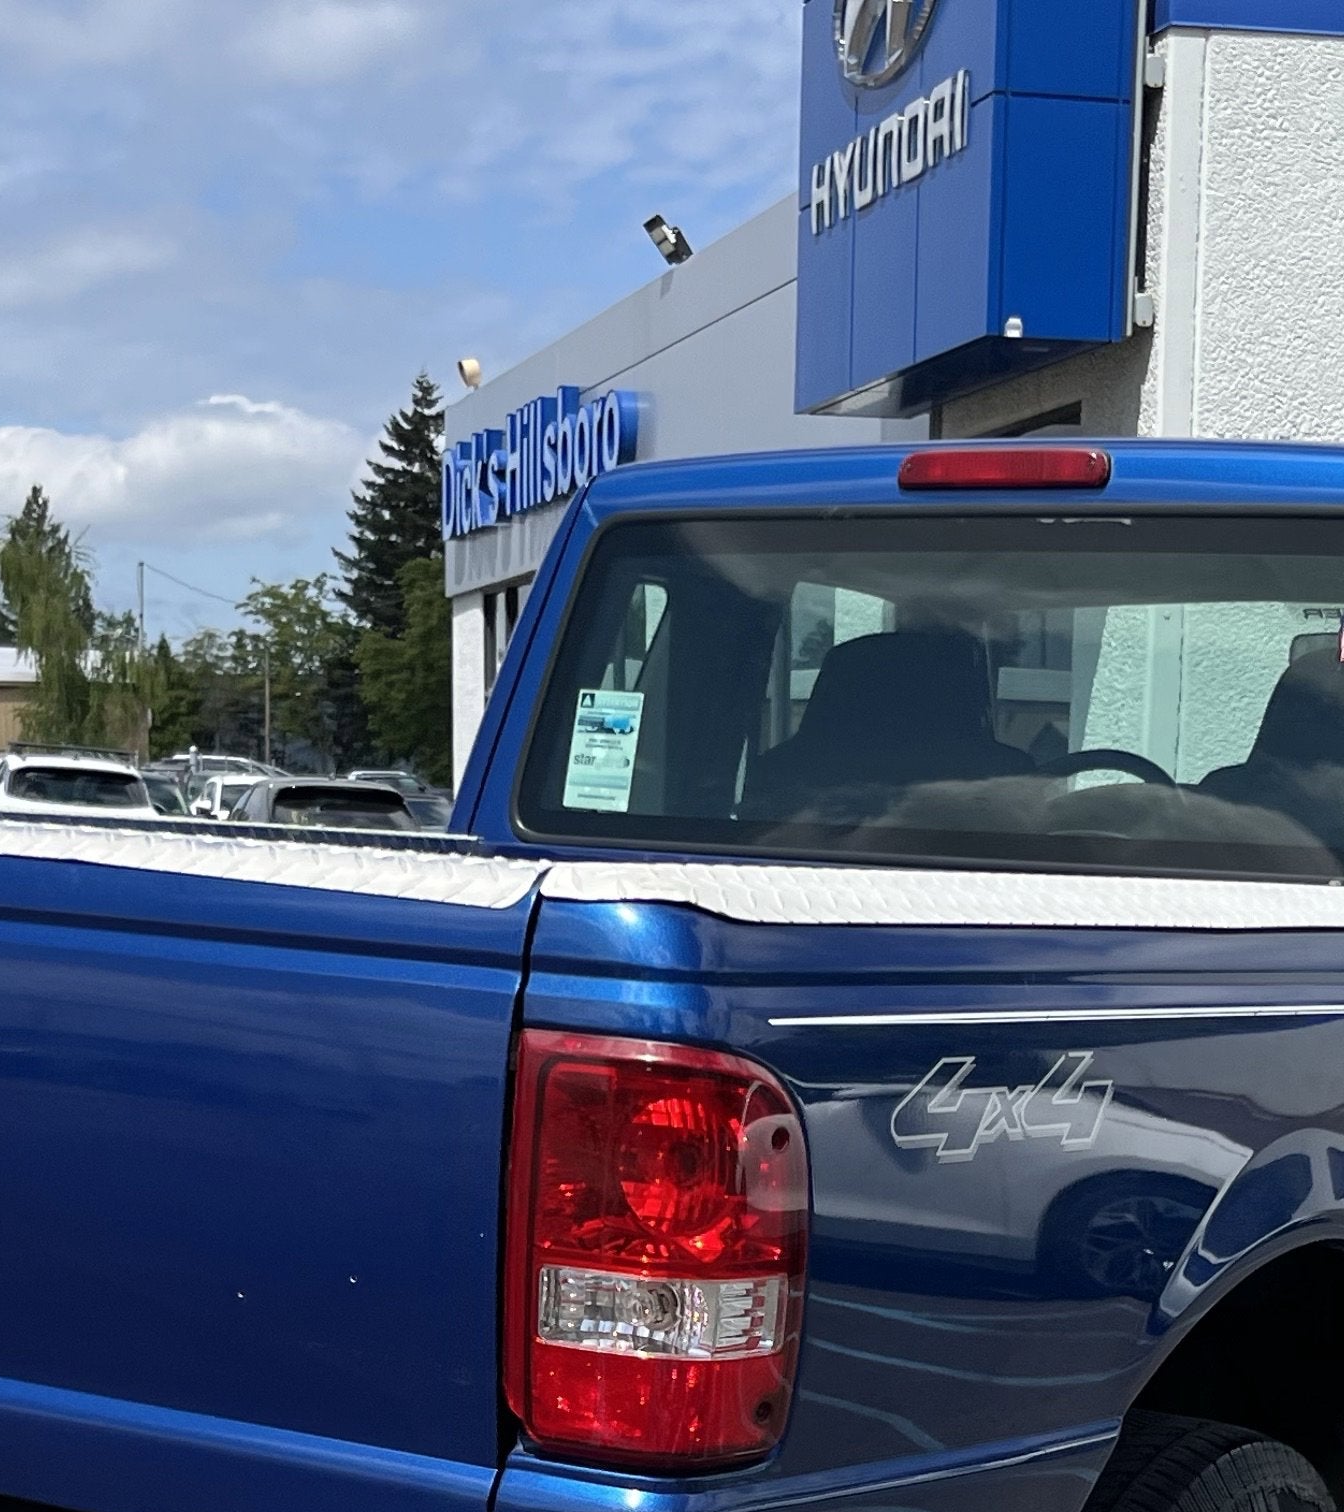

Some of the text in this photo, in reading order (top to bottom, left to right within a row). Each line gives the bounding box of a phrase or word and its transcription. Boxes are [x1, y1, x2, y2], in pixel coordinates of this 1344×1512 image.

[811, 68, 970, 236] HYUNDAI
[442, 386, 626, 541] Dick's Hillsboro
[890, 1050, 1114, 1164] 4x4
